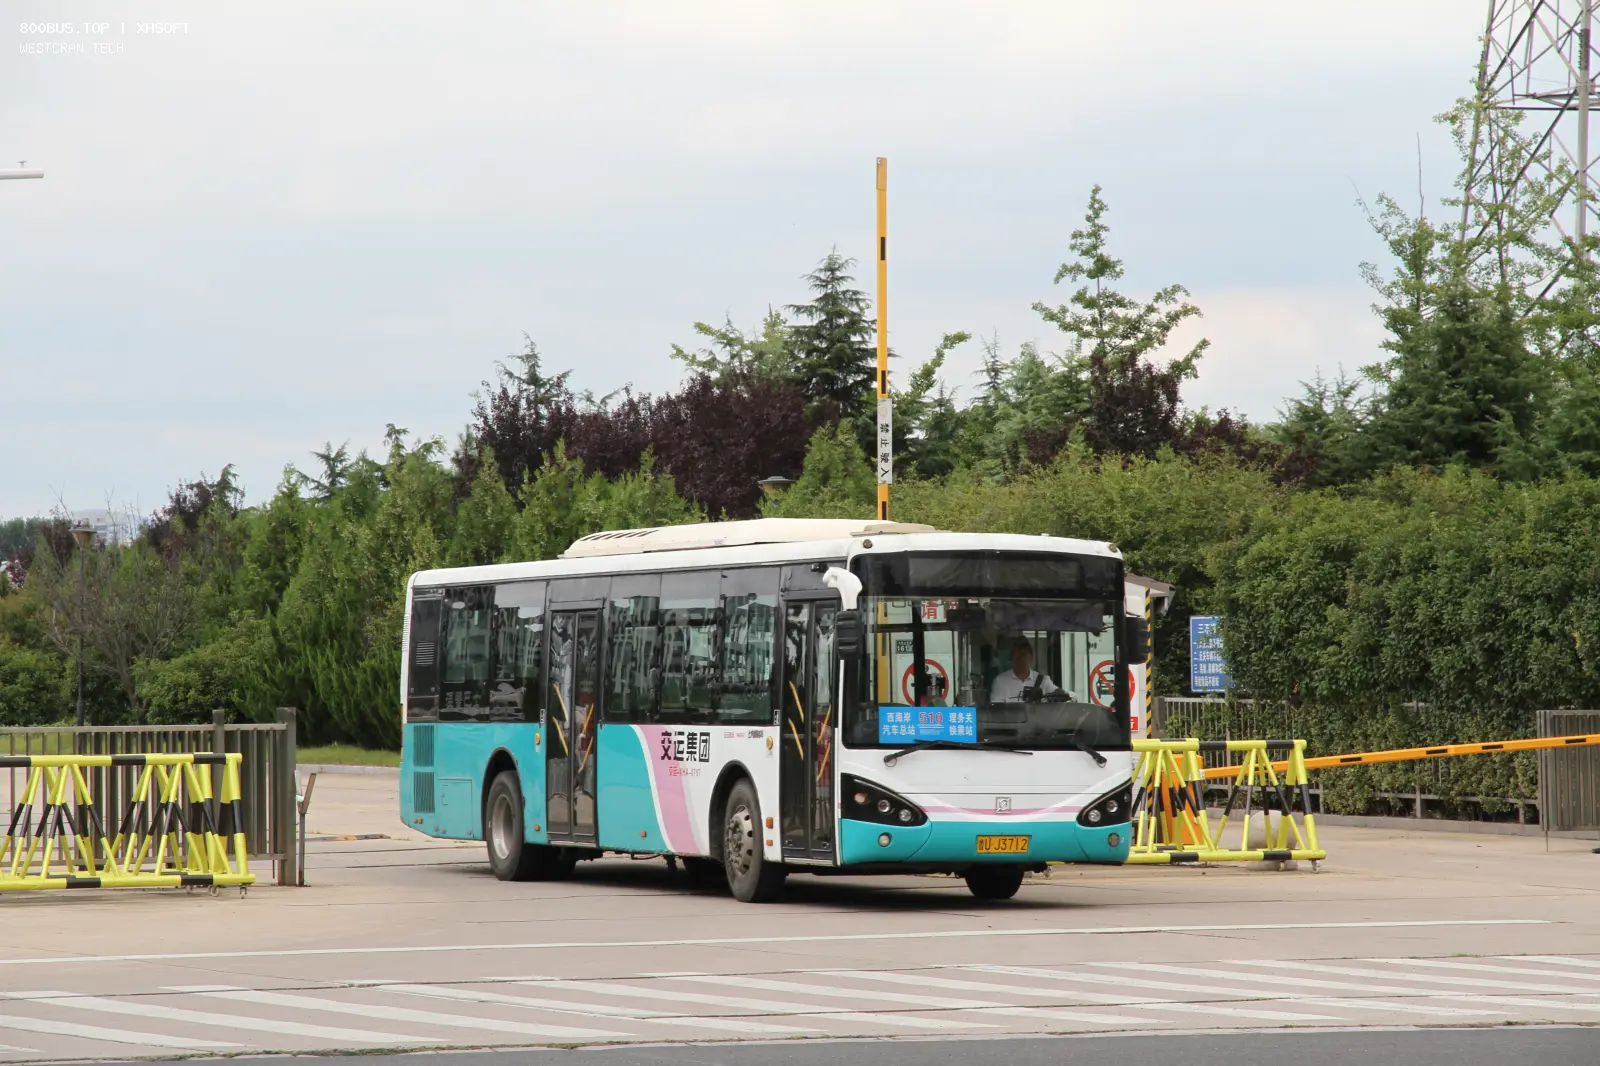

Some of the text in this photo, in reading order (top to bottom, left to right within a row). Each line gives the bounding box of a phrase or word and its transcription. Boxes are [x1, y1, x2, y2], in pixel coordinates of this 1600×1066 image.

[886, 712, 912, 723] 西海岸
[919, 711, 943, 724] 510
[882, 725, 916, 736] 汽车总站
[949, 725, 973, 736] 换乘站
[660, 731, 711, 763] 交运集团
